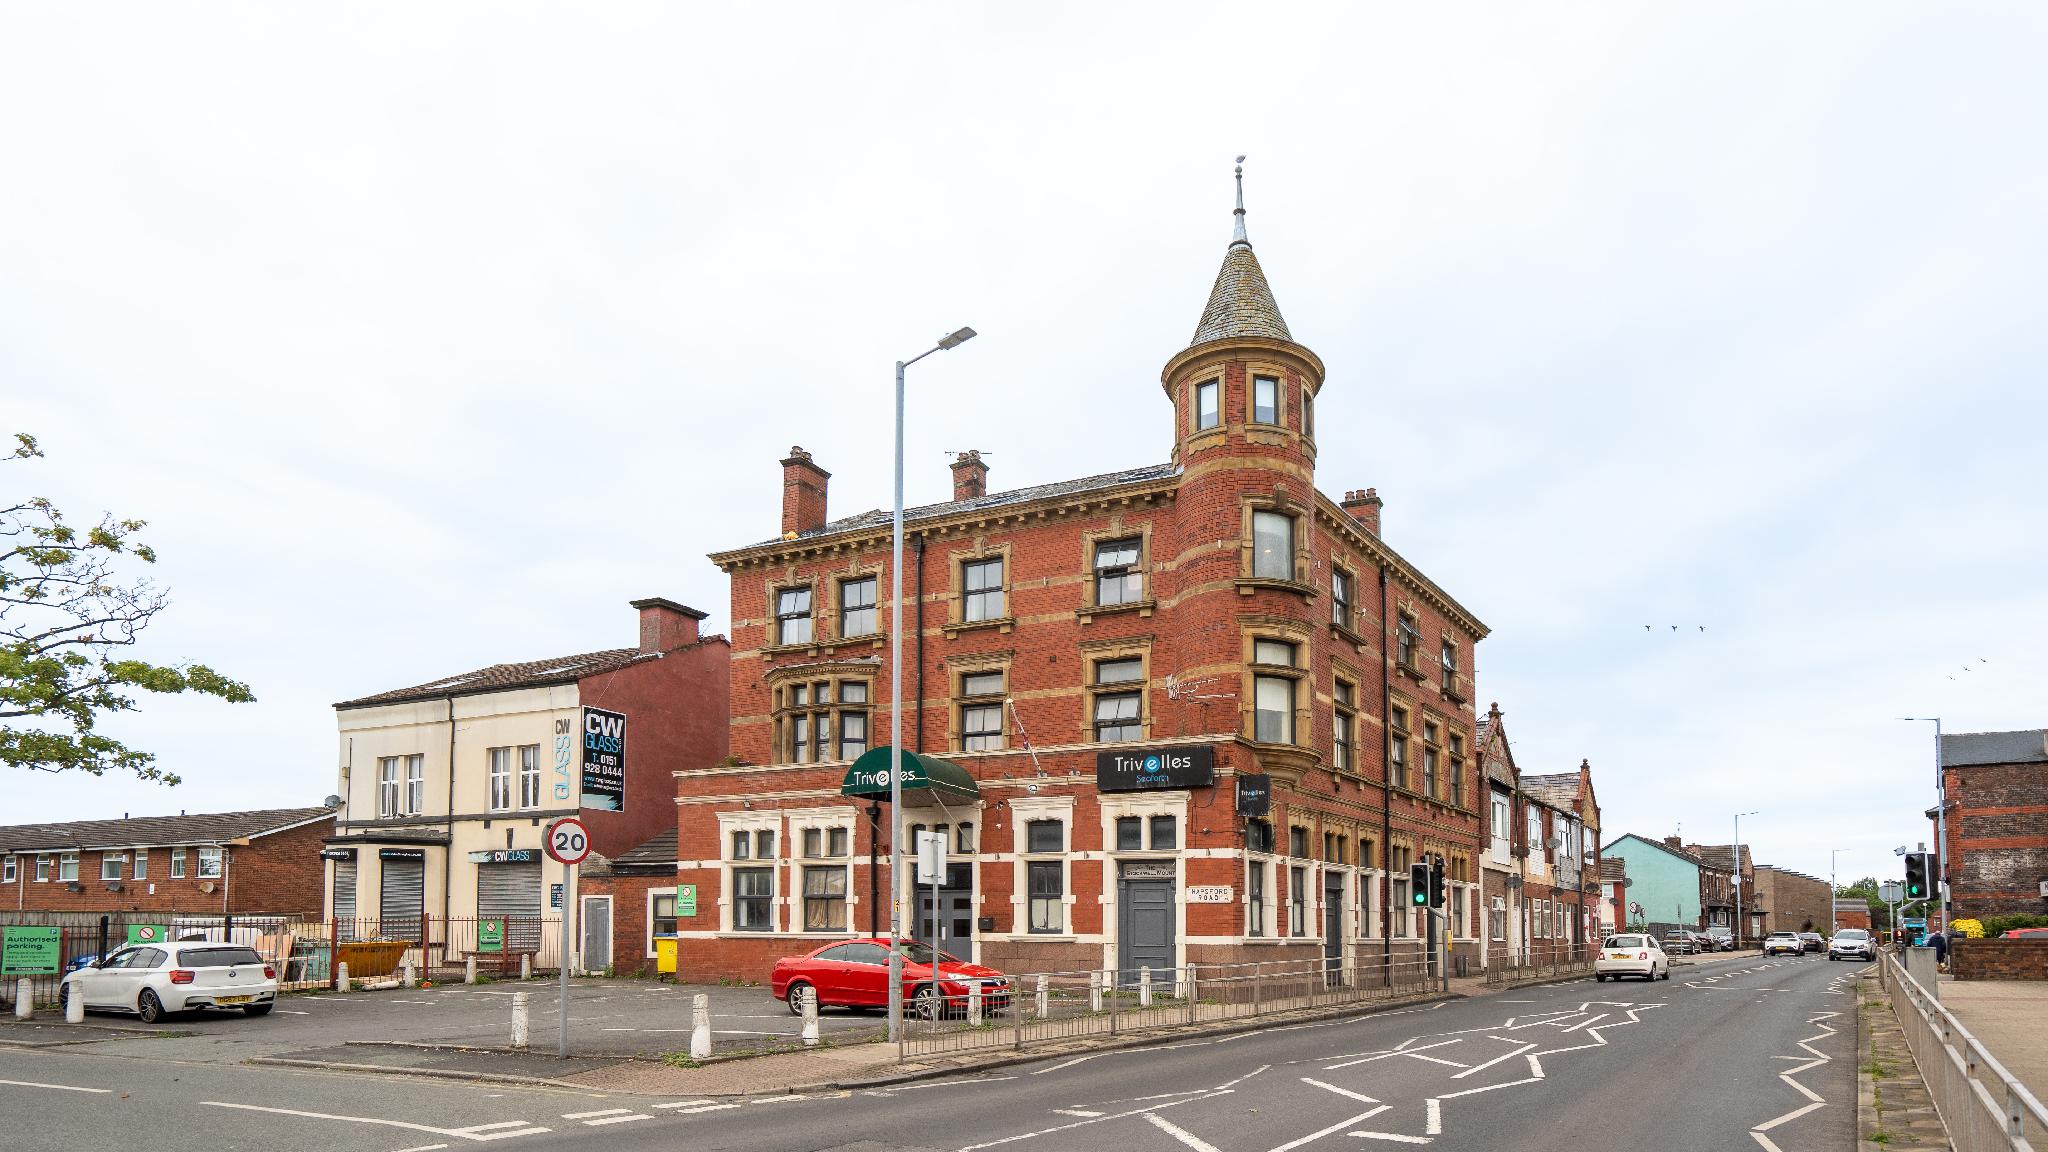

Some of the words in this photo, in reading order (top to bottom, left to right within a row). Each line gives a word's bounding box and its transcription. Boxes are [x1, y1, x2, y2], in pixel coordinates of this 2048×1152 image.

[555, 719, 571, 735] CW
[585, 713, 624, 738] CW
[585, 733, 619, 753] GLASS
[555, 735, 571, 800] GLASS
[584, 762, 601, 774] 928
[602, 765, 623, 778] 0444
[600, 755, 617, 766] 0151
[1114, 753, 1191, 773] Trivelles
[555, 832, 585, 852] 20
[494, 850, 508, 862] CW
[507, 850, 530, 861] GLASS
